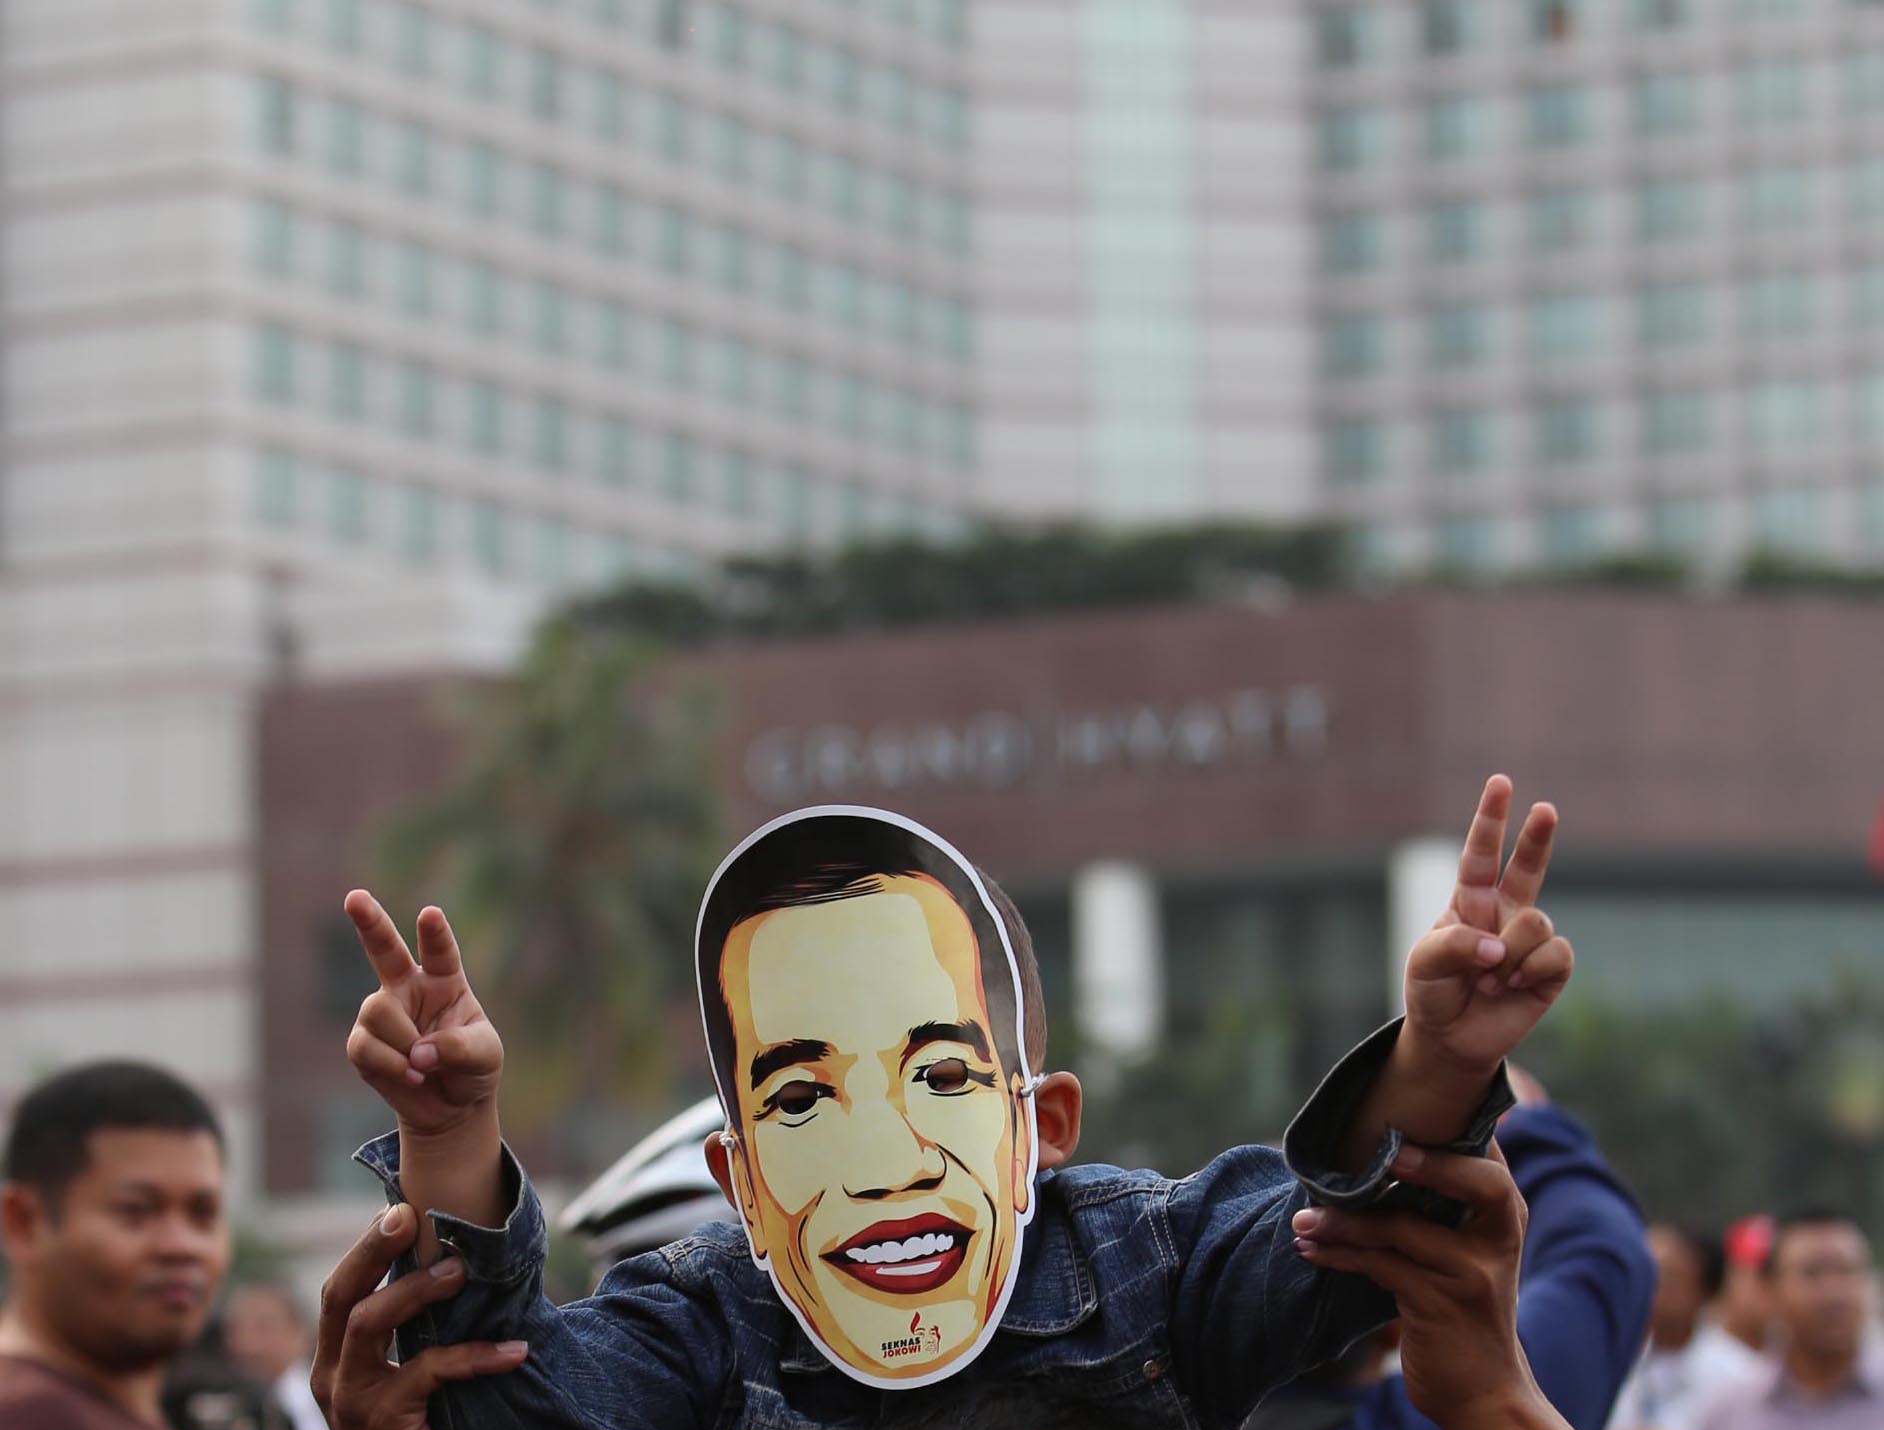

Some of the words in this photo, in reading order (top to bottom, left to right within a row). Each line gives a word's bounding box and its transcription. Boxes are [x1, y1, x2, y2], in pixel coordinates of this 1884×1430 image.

[744, 710, 1033, 802] GRAND
[1056, 684, 1328, 768] HYATT
[881, 1337, 921, 1351] SEKNAS
[883, 1345, 921, 1358] JOKOWI
